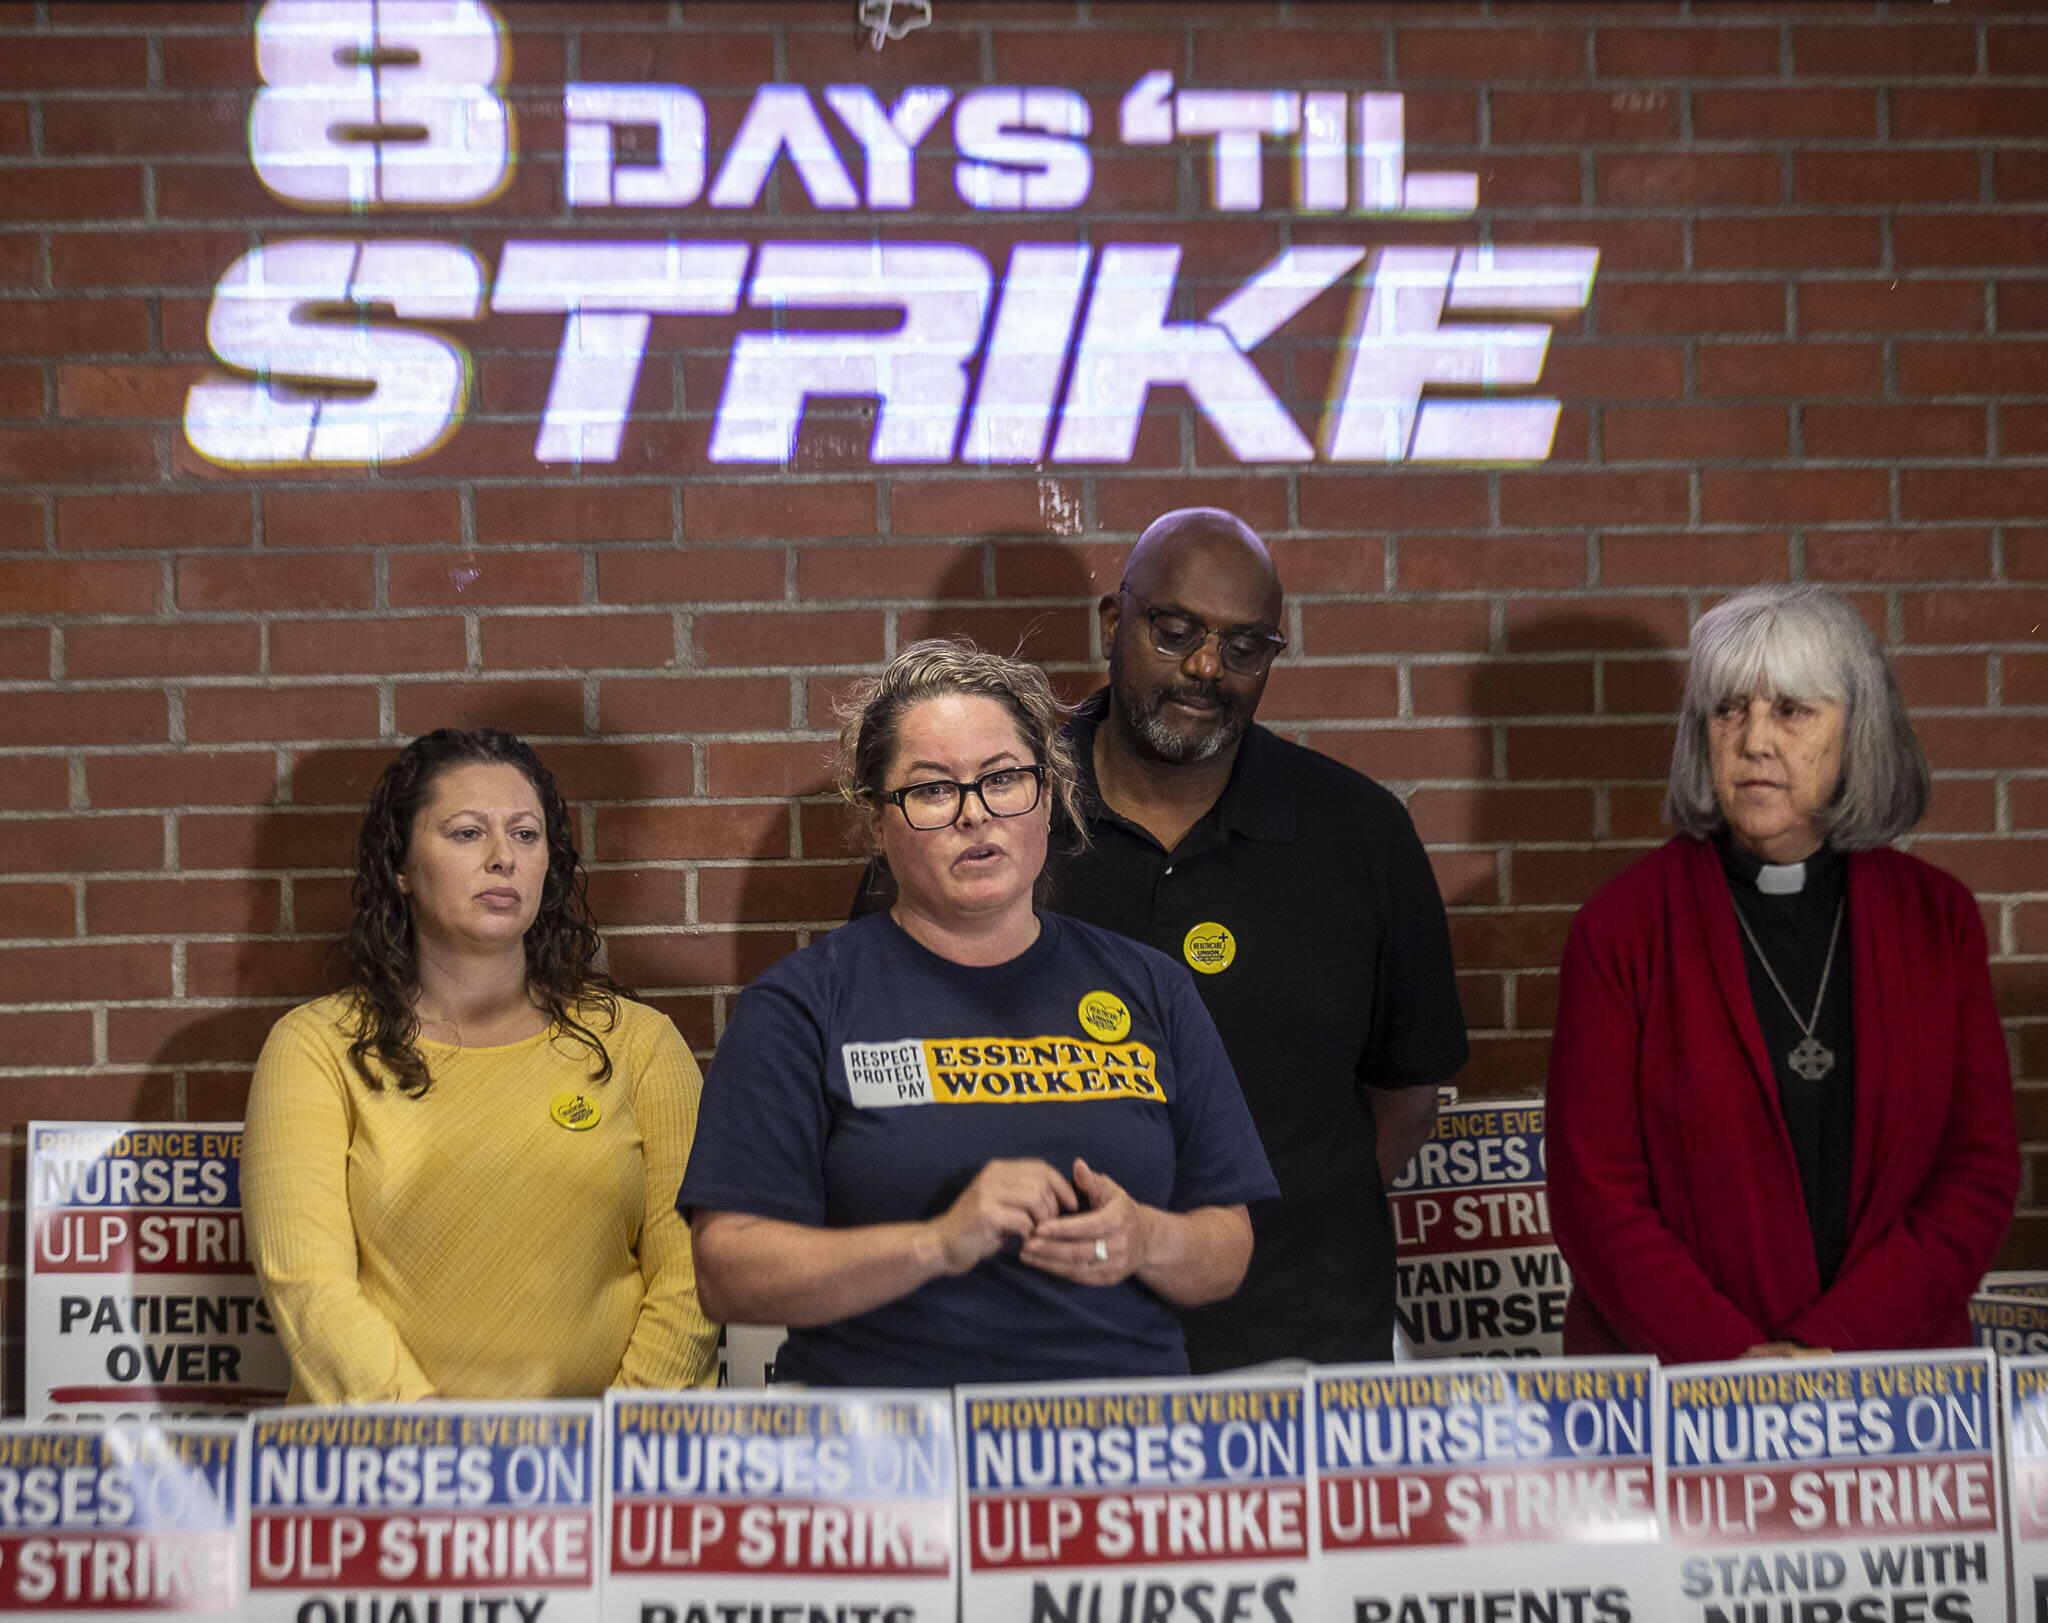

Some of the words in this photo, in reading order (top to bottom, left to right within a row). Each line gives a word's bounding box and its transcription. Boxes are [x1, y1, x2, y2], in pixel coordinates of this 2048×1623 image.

[250, 0, 512, 208] 8
[565, 83, 1093, 210] DAYS
[184, 238, 1600, 467] STRIKE
[850, 1046, 919, 1067] RESPECT
[853, 1064, 923, 1084] PROTECT
[932, 1042, 1150, 1069] ESSENTIAL
[898, 1081, 925, 1099] PAY
[938, 1068, 1156, 1096] WORKERS
[40, 1132, 197, 1158] PROVIDENCE
[1429, 1112, 1498, 1140] ENCE
[42, 1158, 228, 1205] NURSES
[42, 1215, 129, 1263] ULP
[139, 1215, 251, 1264] STRI
[106, 1344, 241, 1383] OVER
[1671, 1368, 1854, 1410] PROVIDENCE
[1860, 1363, 1987, 1398] EVERETT
[971, 1393, 1164, 1432] PROVIDENCE
[1171, 1388, 1298, 1425] EVERETT
[1320, 1371, 1508, 1411] PROVIDENCE
[1517, 1368, 1648, 1402] EVERETT
[259, 1415, 453, 1446] PROVIDENCE
[461, 1413, 589, 1446] EVERETT
[619, 1402, 811, 1434] PROVIDENCE
[1323, 1402, 1552, 1466] NURSES
[1563, 1397, 1645, 1456] ON
[1674, 1397, 1897, 1465] NURSES
[1906, 1392, 1983, 1452] ON
[259, 1446, 494, 1505] NURSES
[506, 1446, 584, 1506] ON
[620, 1435, 851, 1493] NURSES
[866, 1438, 941, 1494] ON
[975, 1423, 1207, 1489] NURSES
[1218, 1419, 1298, 1481] ON
[1328, 1477, 1433, 1542] ULP
[1444, 1467, 1649, 1537] STRIKE
[1675, 1473, 1778, 1532] ULP
[1789, 1462, 1992, 1530] STRIKE
[258, 1516, 366, 1580] ULP
[378, 1515, 588, 1580] STRIKE
[620, 1503, 725, 1565] ULP
[737, 1506, 947, 1568] STRIKE
[978, 1499, 1084, 1562] ULP
[1096, 1491, 1303, 1558] STRIKE
[1680, 1552, 1847, 1598] STAND
[1860, 1542, 1989, 1589] WITH
